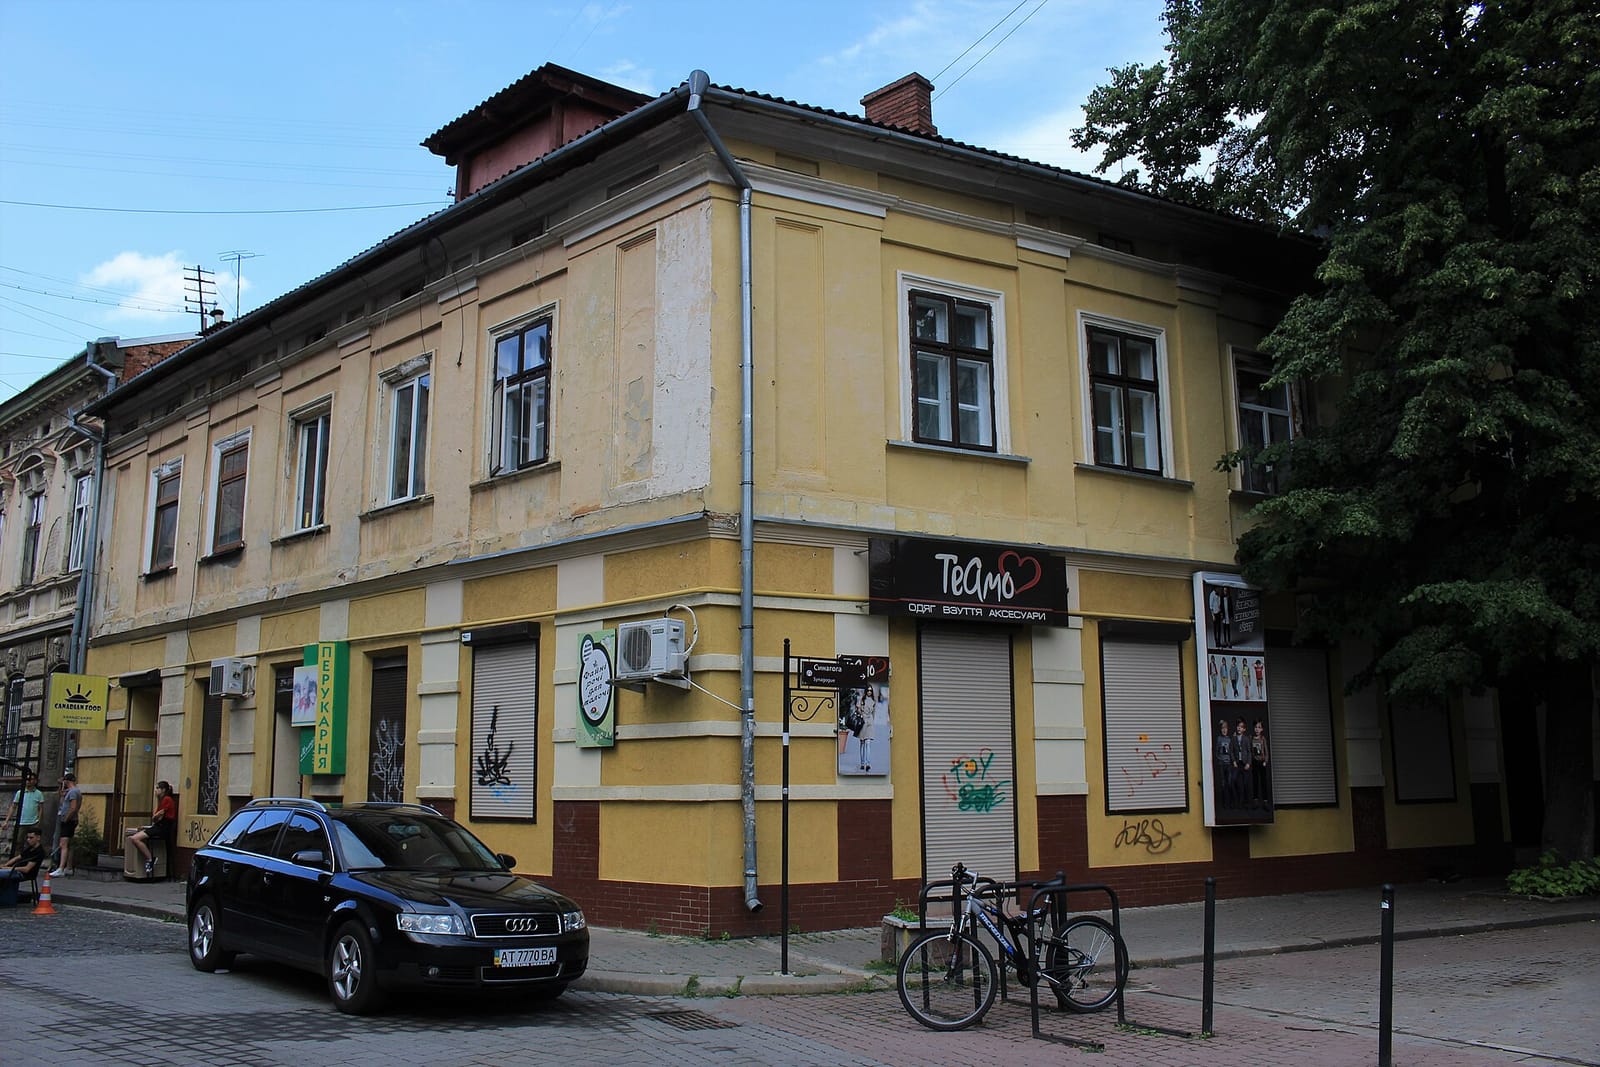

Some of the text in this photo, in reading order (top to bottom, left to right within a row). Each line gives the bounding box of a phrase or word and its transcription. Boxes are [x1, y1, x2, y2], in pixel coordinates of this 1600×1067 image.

[908, 603, 1046, 621] ОДЯГ ВЗУТТЯ АКСЕСУАРИ
[318, 646, 332, 769] ПЕРУКАРНЯ
[501, 949, 555, 963] AT 7770 BA
